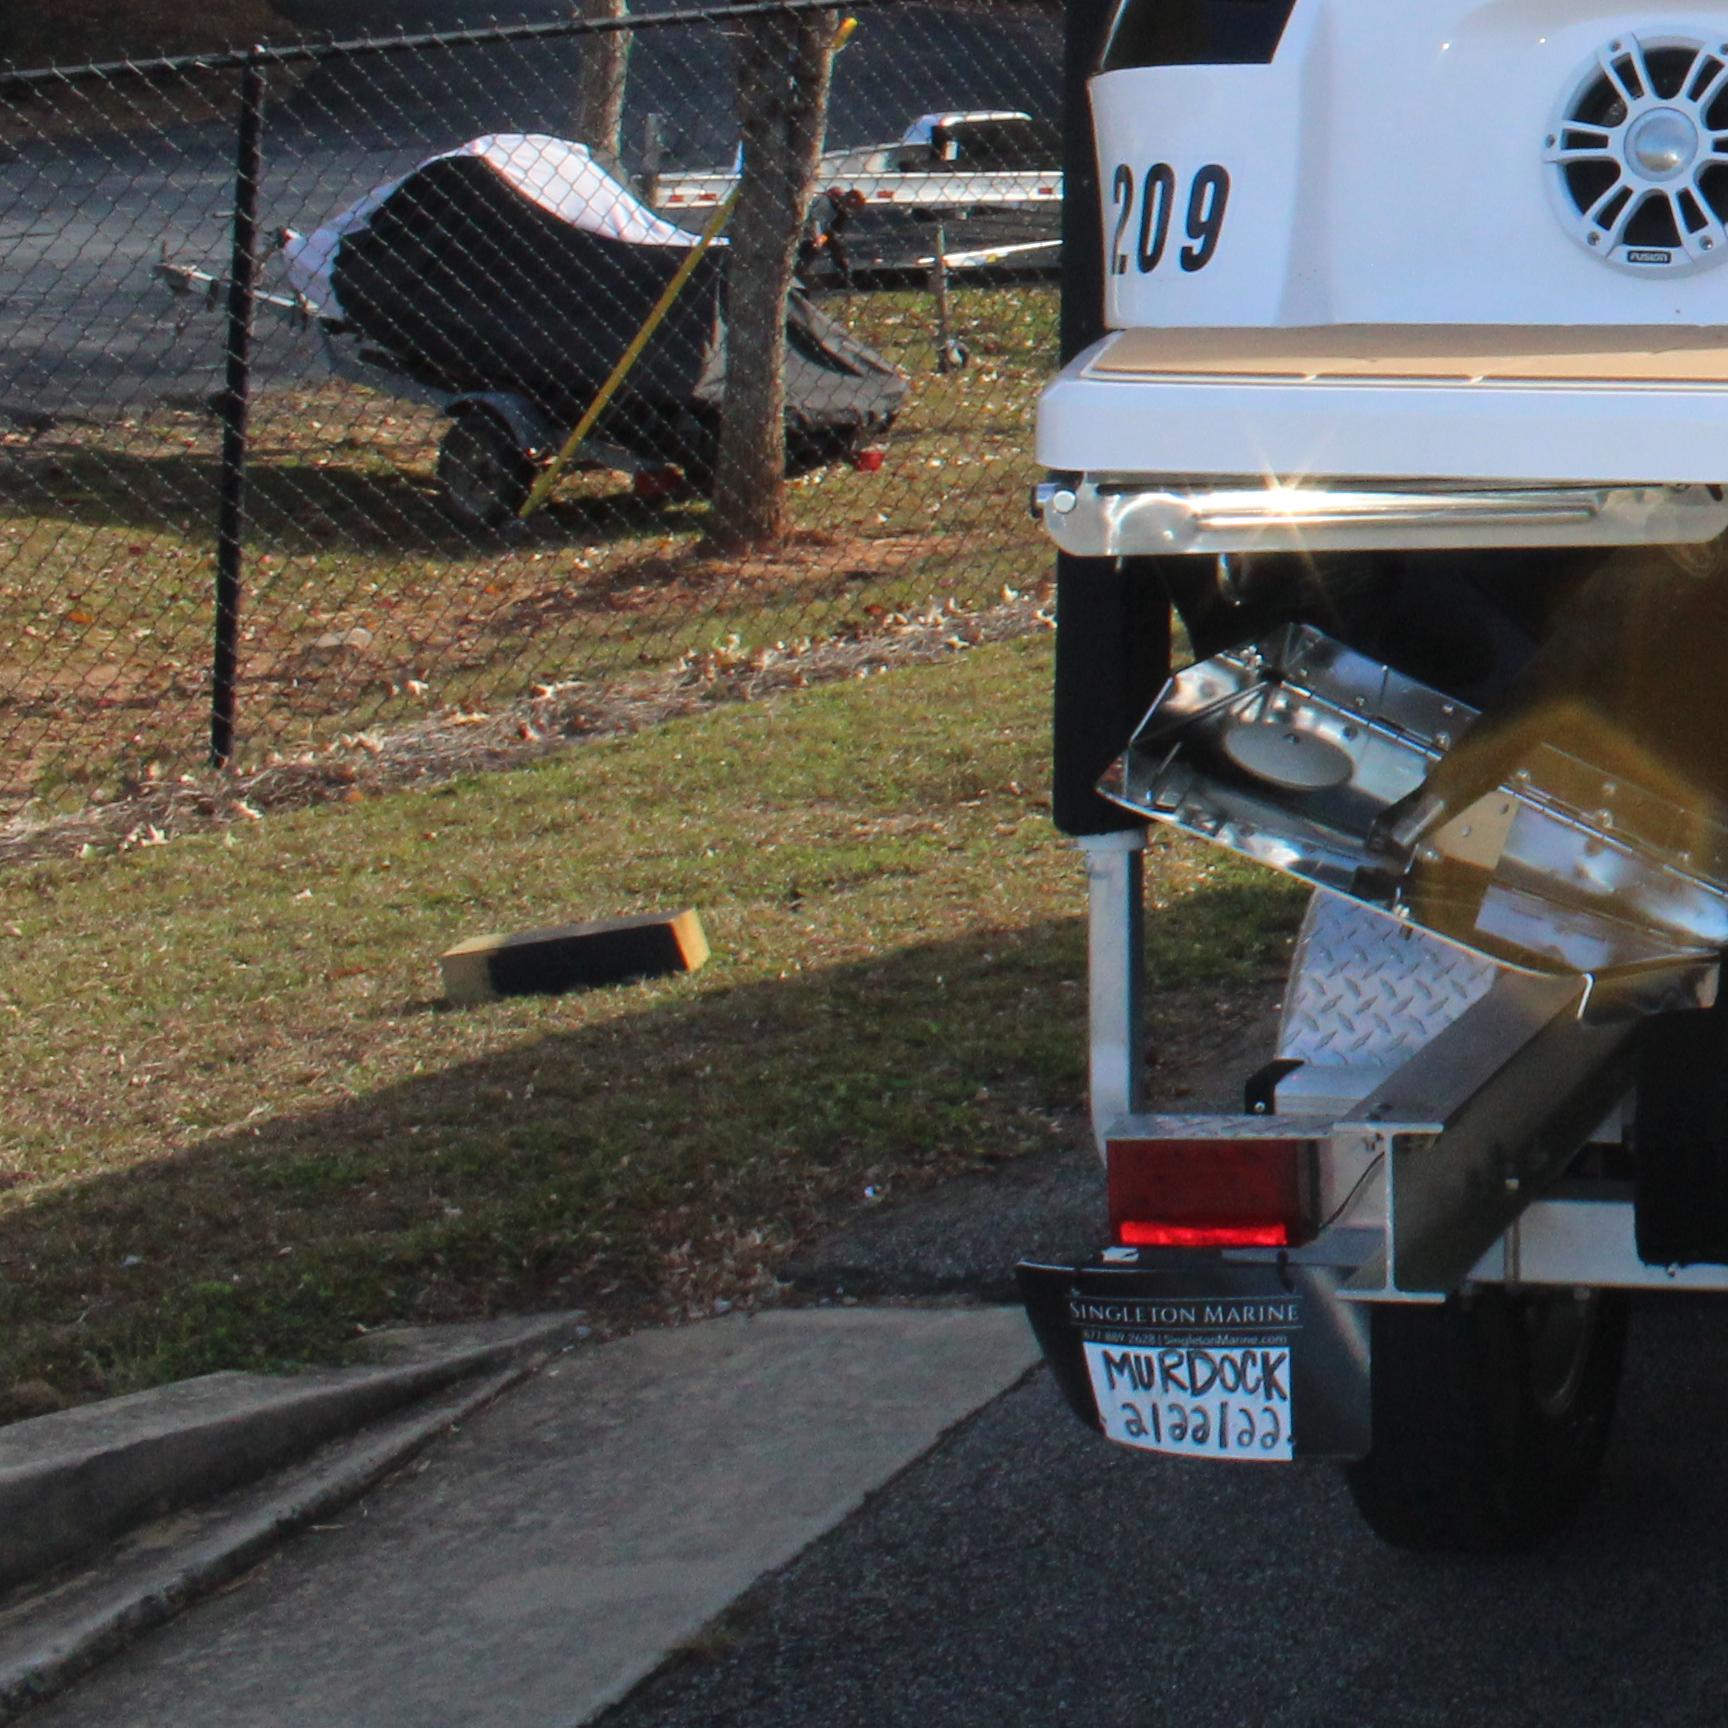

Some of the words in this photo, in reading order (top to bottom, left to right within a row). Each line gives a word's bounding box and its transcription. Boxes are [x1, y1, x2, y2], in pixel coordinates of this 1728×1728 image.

[1111, 162, 1231, 275] 209
[1069, 1301, 1195, 1323] SINGLETON
[1203, 1304, 1299, 1323] MARINE
[1103, 1348, 1288, 1401] MURDOCK
